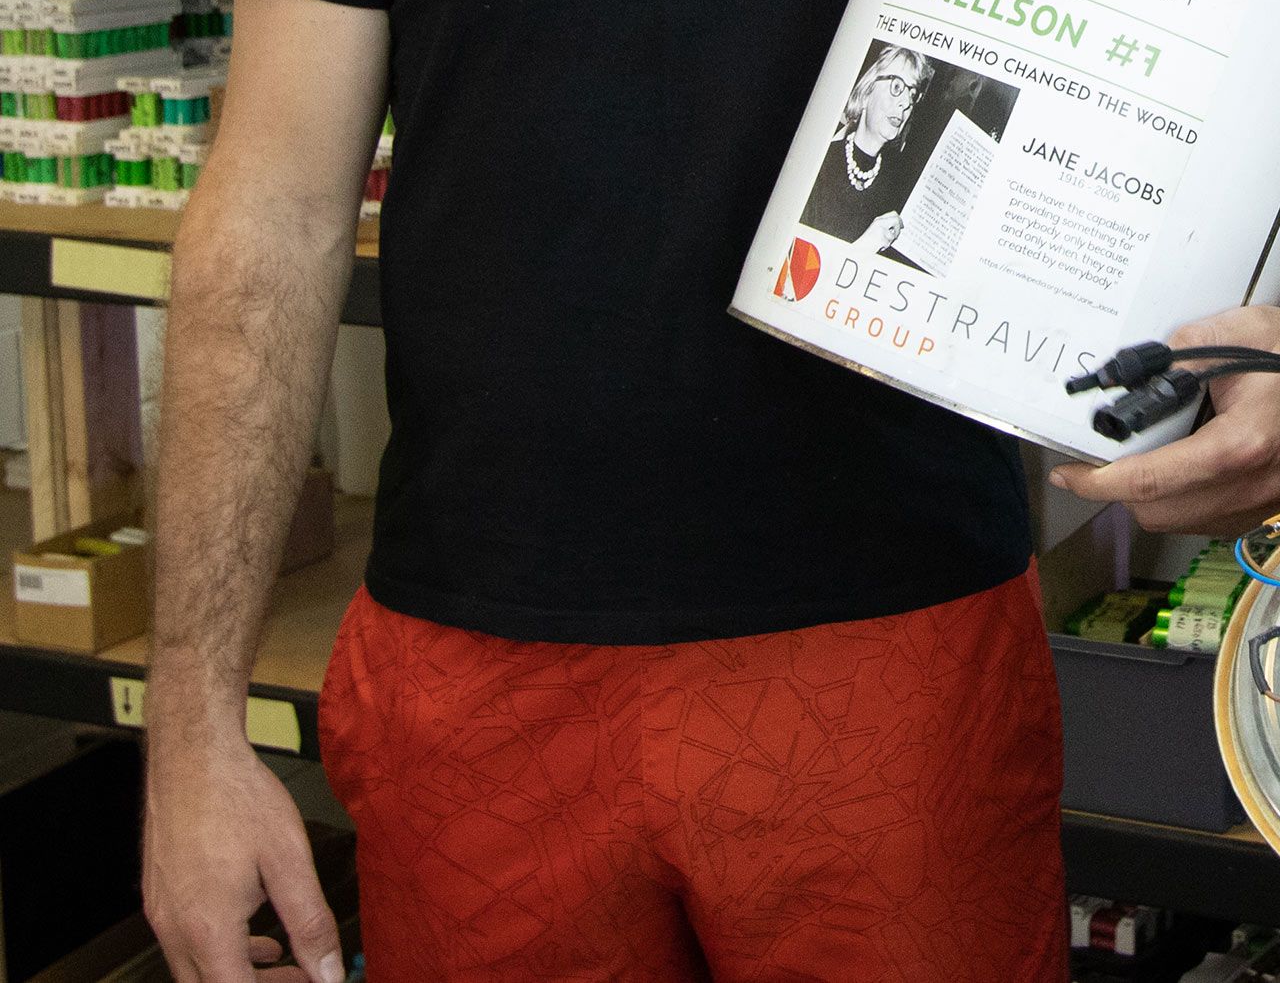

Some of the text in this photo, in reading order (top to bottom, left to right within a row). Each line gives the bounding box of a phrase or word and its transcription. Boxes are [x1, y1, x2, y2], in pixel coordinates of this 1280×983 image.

[876, 14, 1199, 146] THE WOMEN WHO CHANGED THE WORLD
[1105, 33, 1163, 78] #7
[1021, 137, 1166, 206] JANE JACOBS
[1057, 170, 1085, 190] 1916
[1093, 184, 1121, 205] 2006
[1008, 195, 1136, 252] providing something for
[1038, 187, 1065, 211] have
[1066, 202, 1086, 218] the
[1086, 209, 1137, 241] capability
[1136, 231, 1151, 243] of
[1063, 229, 1087, 252] only
[997, 236, 1041, 262] created
[1041, 252, 1057, 269] by
[1000, 222, 1024, 240] and
[1023, 232, 1048, 252] only
[1081, 253, 1105, 274] they
[1105, 265, 1125, 279] are
[824, 298, 936, 357] GROUP
[834, 257, 1097, 380] DESTRAVIS
